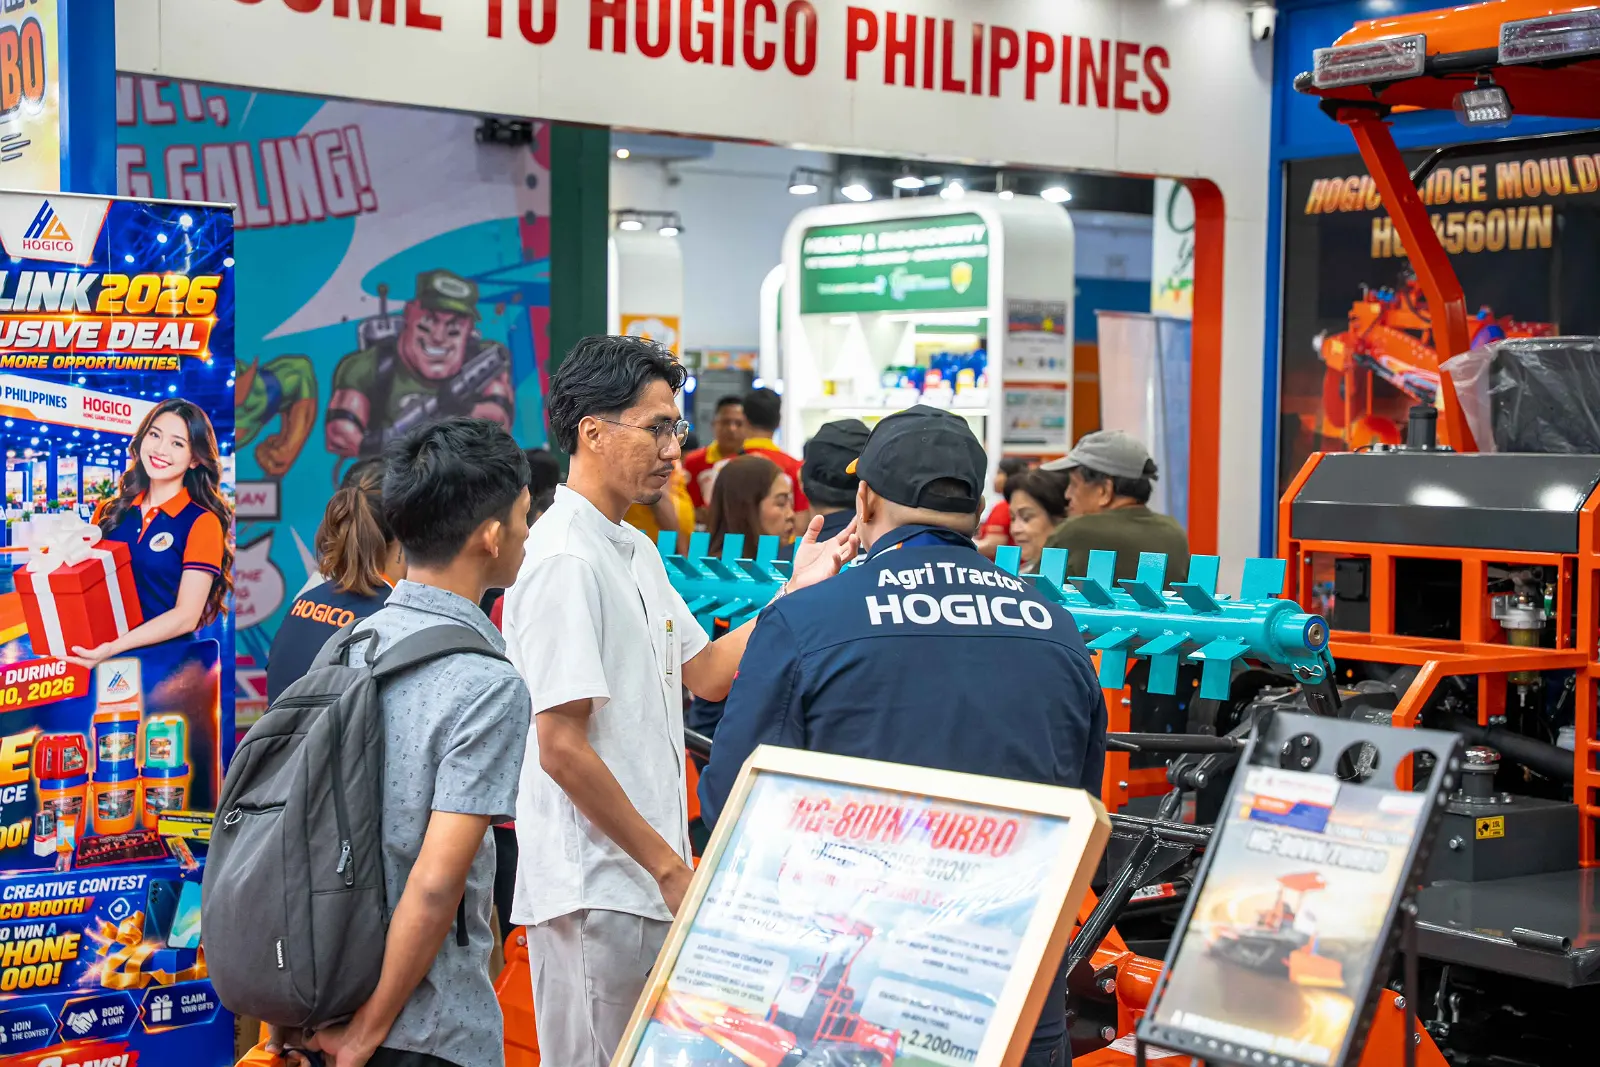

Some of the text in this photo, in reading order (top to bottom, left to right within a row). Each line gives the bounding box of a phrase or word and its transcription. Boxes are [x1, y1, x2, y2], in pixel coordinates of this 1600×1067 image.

[588, 0, 818, 77] HOGICO
[845, 6, 1171, 115] PHILIPPINES
[164, 124, 379, 231] GALING!
[1416, 163, 1488, 206] IDGE
[22, 239, 74, 252] HOGICO
[96, 273, 222, 316] 2026
[107, 321, 201, 350] DEAL
[1, 355, 180, 370] MORE OPPORTUNITIES.
[5, 385, 132, 417] PHILIPPINES HOGICO
[877, 562, 1026, 593] Agri Tractor
[291, 599, 355, 628] HOGICO
[865, 593, 1053, 630] HOGICO
[5, 660, 68, 686] DURING
[27, 675, 76, 702] 2026
[0, 783, 28, 805] CE
[3, 874, 147, 901] CREATIVE CONTEST
[27, 897, 86, 918] BOOTH
[14, 923, 45, 940] WIN
[46, 922, 57, 937] A
[102, 1005, 125, 1017] BOOK
[181, 993, 207, 1005] CLAIM
[11, 1020, 32, 1032] JOIN
[108, 1016, 124, 1026] UNIT
[11, 1028, 49, 1042] THE CONTEST
